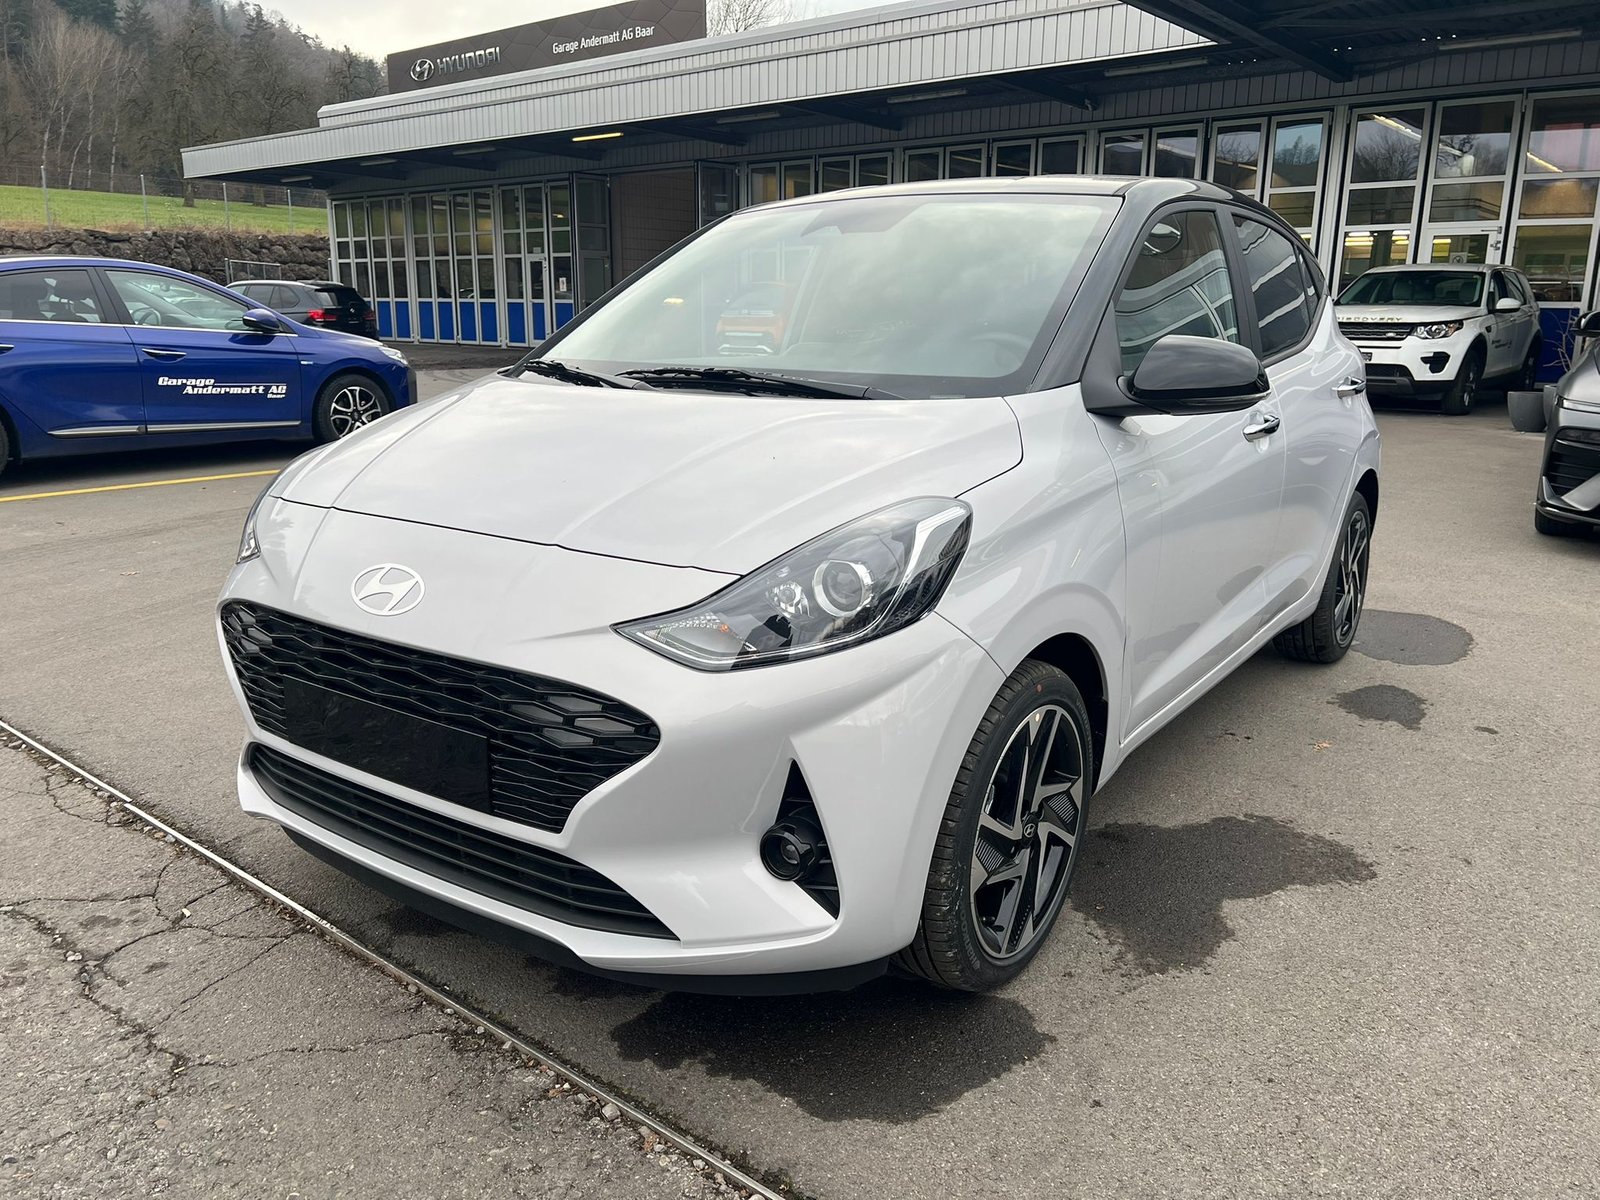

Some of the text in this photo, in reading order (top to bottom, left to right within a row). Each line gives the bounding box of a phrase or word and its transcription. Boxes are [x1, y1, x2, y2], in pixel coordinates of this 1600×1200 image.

[552, 25, 655, 54] Garage Andermatt AG Baar
[437, 47, 501, 75] HYUNDAI
[158, 376, 215, 386] Garage
[183, 385, 287, 394] Andermatt AG
